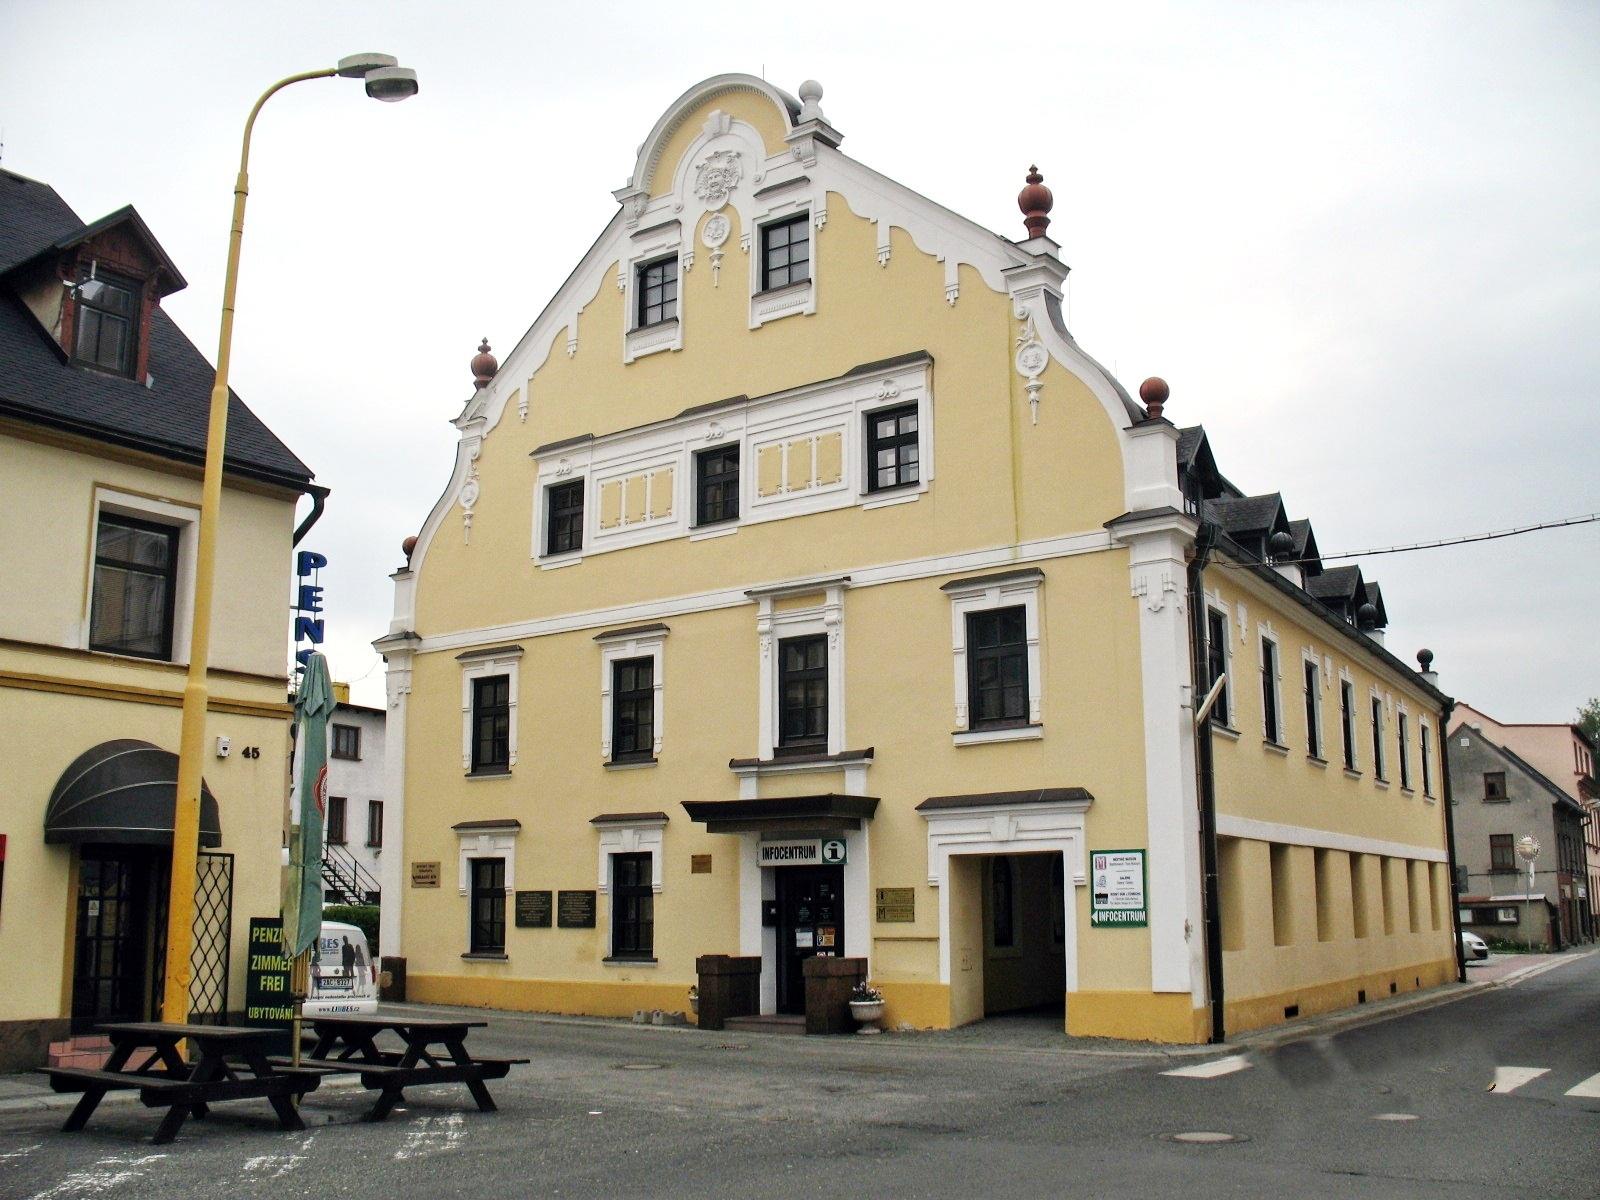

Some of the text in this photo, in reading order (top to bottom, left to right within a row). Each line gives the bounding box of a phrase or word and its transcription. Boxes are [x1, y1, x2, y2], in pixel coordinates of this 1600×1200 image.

[242, 746, 260, 759] 45
[762, 845, 816, 860] INFOCENTRUM
[1099, 911, 1146, 922] INFOCENTRUM
[252, 927, 283, 943] PENZI
[260, 975, 284, 991] FREI
[248, 1005, 294, 1019] UBYTOVÁNÍ
